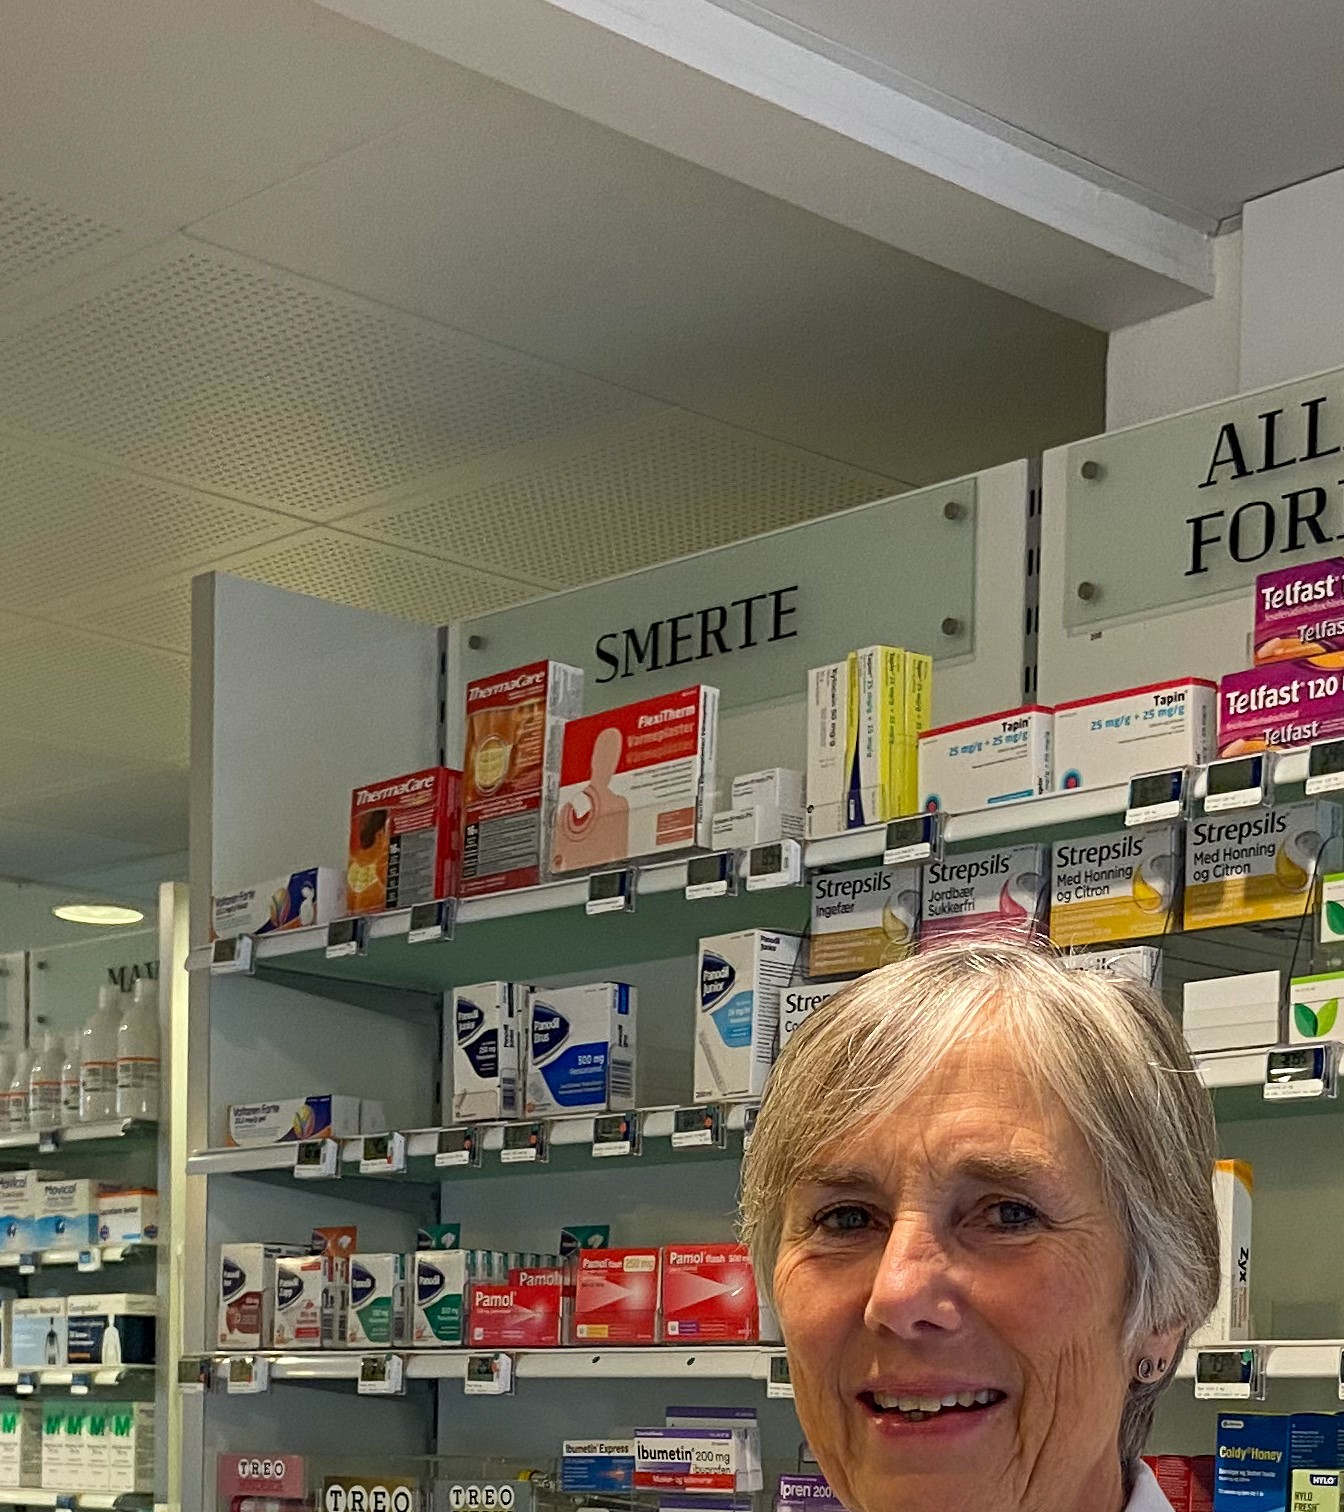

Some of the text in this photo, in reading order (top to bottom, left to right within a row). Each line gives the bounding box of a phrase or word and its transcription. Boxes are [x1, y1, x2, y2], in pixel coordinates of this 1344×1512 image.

[1261, 574, 1336, 611] Telfast
[595, 586, 799, 684] SMERTE
[468, 671, 545, 701] ThermaCare
[1226, 684, 1300, 715] Telfast
[1307, 675, 1338, 699] 120
[1153, 691, 1186, 707] Tapin
[638, 704, 695, 729] FlexiTherm
[1001, 719, 1030, 733] Tapin
[1263, 720, 1320, 745] Telfast
[355, 772, 434, 808] ThermaCare
[1193, 814, 1287, 846] Strepsils
[1056, 836, 1144, 867] Strepsils
[1194, 842, 1276, 866] Med Honning
[927, 853, 1010, 884] Strepsils
[1056, 865, 1133, 887] Med Honning
[1193, 862, 1251, 883] og Citron
[815, 872, 891, 900] Strepsils
[927, 886, 975, 903] Jordbær
[1056, 883, 1109, 904] og Citron
[816, 902, 855, 920] Ingefær
[927, 899, 976, 918] Sukkerfri
[533, 1018, 560, 1032] Panodil
[669, 1251, 704, 1265] Pamol
[419, 1275, 440, 1286] Panodil
[475, 1291, 514, 1307] Pamol
[599, 1443, 630, 1455] Express
[636, 1439, 730, 1465] Ibumetin 200 mg
[450, 1485, 514, 1508] TREO
[780, 1480, 811, 1499] Ipren
[1294, 1492, 1312, 1501] HYLO
[1294, 1503, 1317, 1512] FRESH
